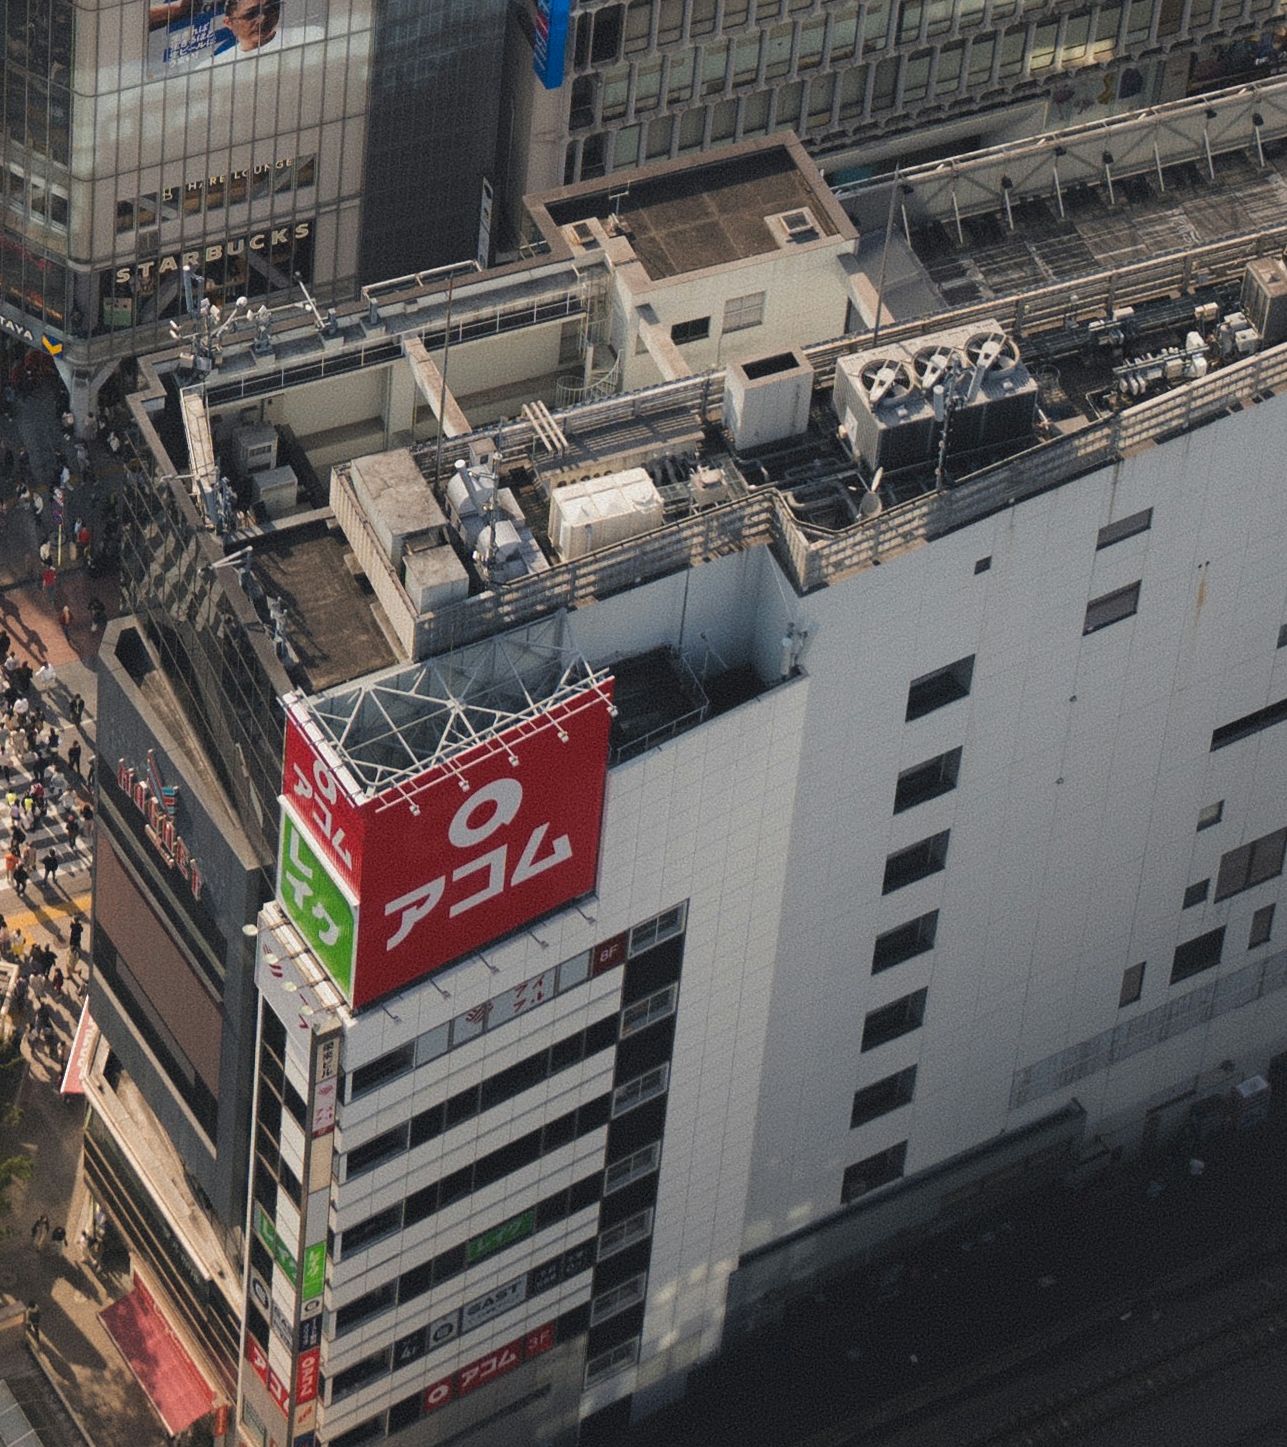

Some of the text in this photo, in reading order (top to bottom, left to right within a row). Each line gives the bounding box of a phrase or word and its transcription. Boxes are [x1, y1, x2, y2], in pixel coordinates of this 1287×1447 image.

[116, 222, 311, 284] STARBUCKS
[384, 819, 577, 950] アコム
